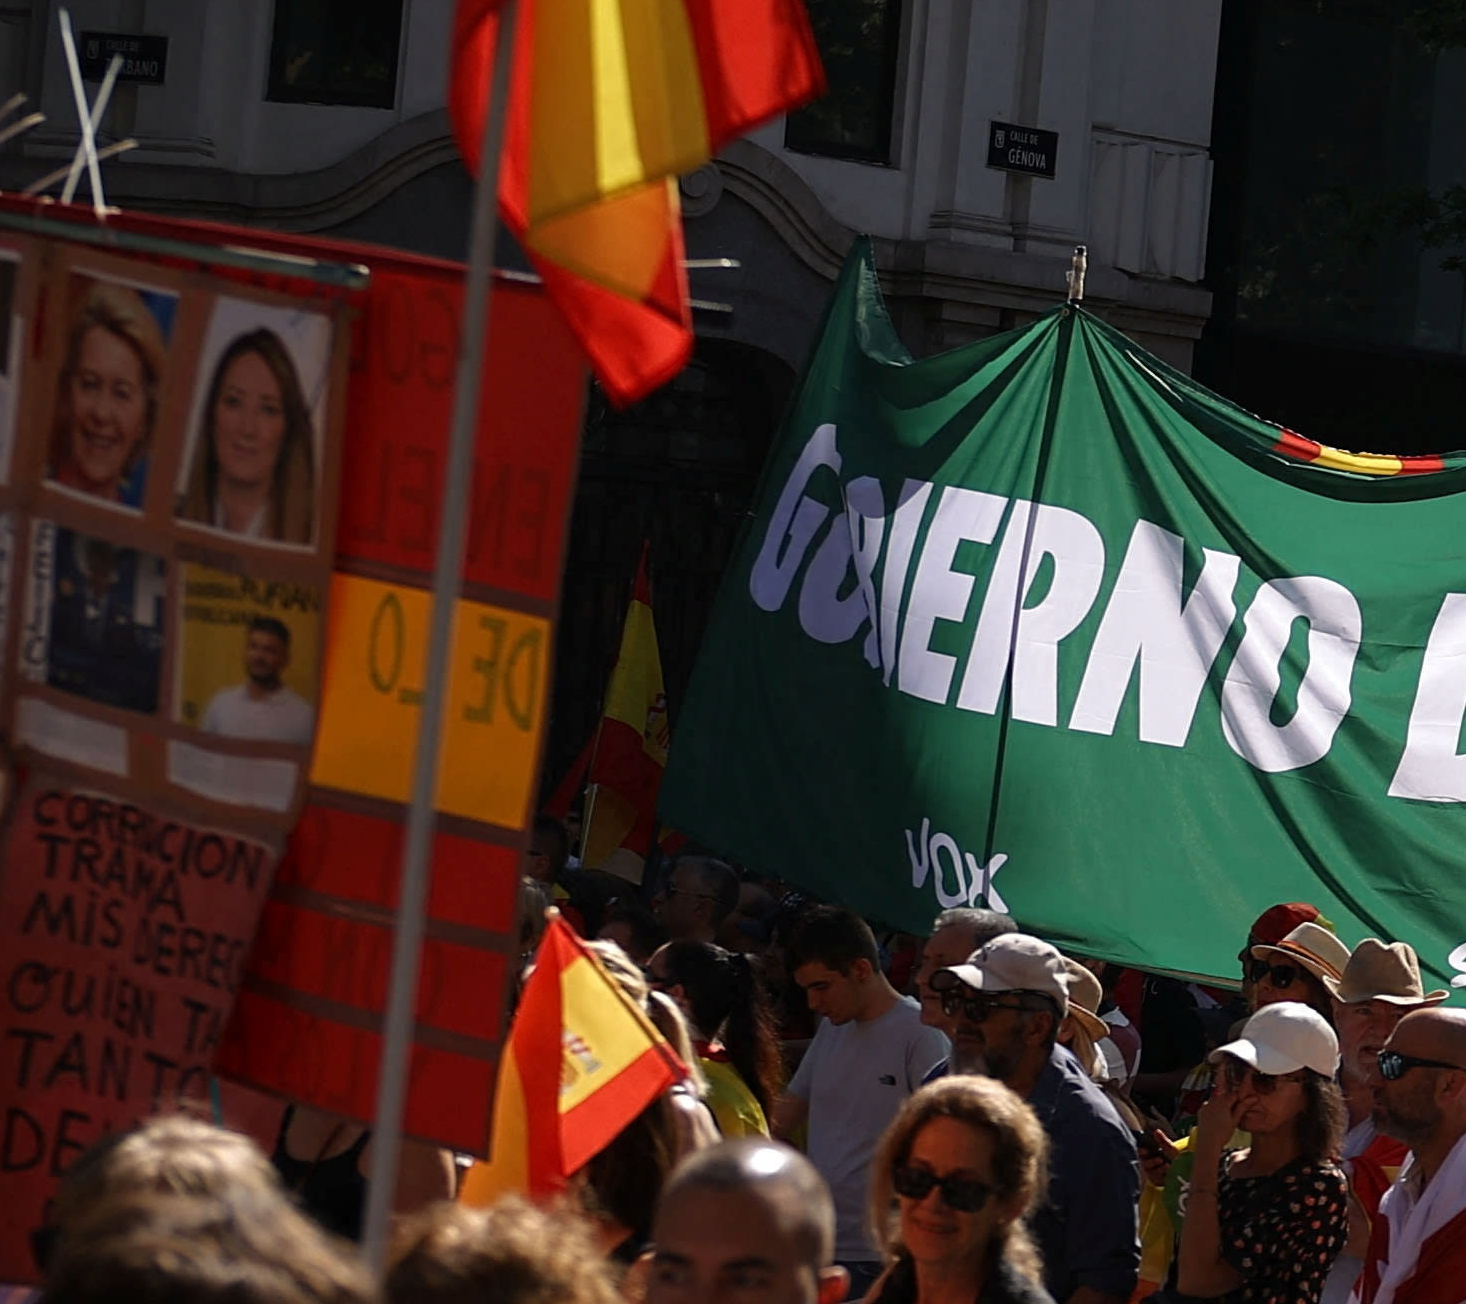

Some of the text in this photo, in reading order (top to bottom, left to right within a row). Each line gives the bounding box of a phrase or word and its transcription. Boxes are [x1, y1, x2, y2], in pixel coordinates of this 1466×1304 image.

[1009, 128, 1039, 146] CALLE DE
[1008, 147, 1047, 169] GÉNOVA
[905, 817, 1010, 914] VOX
